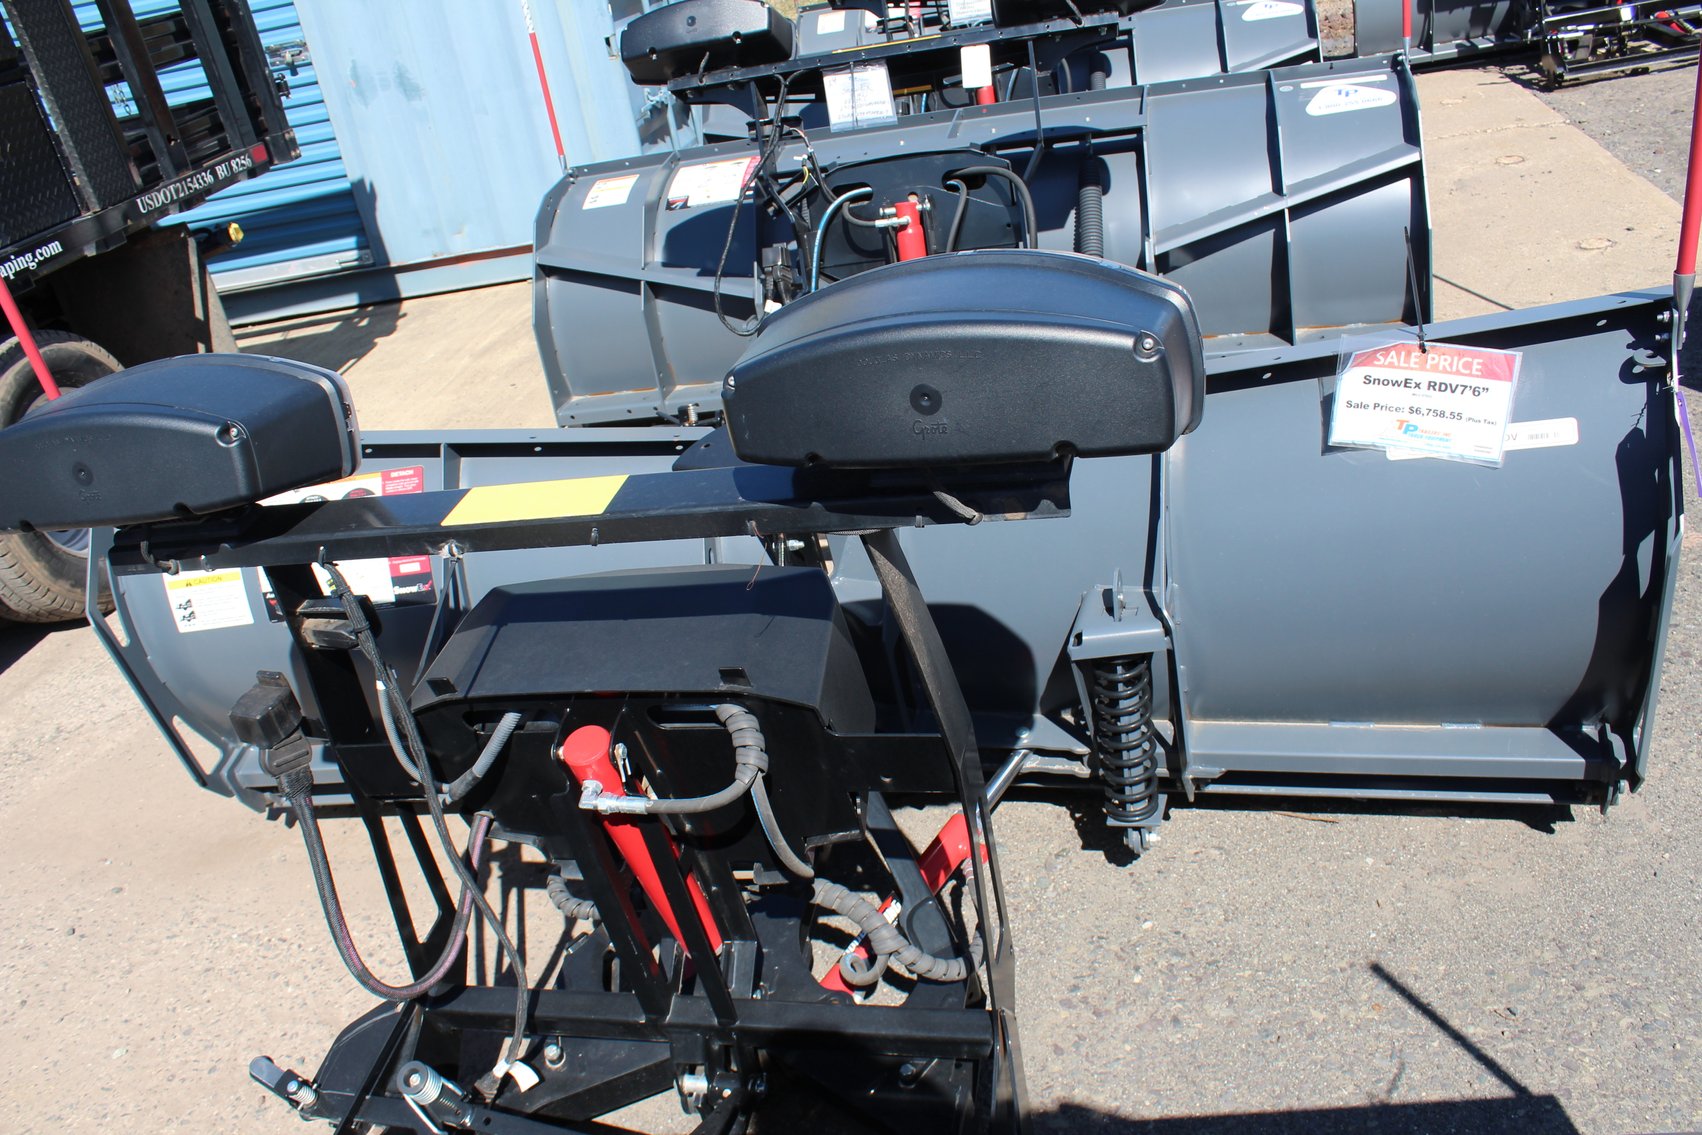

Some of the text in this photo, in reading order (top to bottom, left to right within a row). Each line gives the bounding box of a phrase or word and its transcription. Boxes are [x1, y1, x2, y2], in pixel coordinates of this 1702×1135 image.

[136, 153, 252, 213] USDOT2154336 BU 8256
[1373, 350, 1484, 375] SALE PRICE
[1362, 374, 1421, 390] SnowEx
[1345, 400, 1498, 426] Sale Price: $6,758.55 (Plus Tax)
[912, 418, 948, 440] Grote
[193, 576, 223, 585] CAUTION
